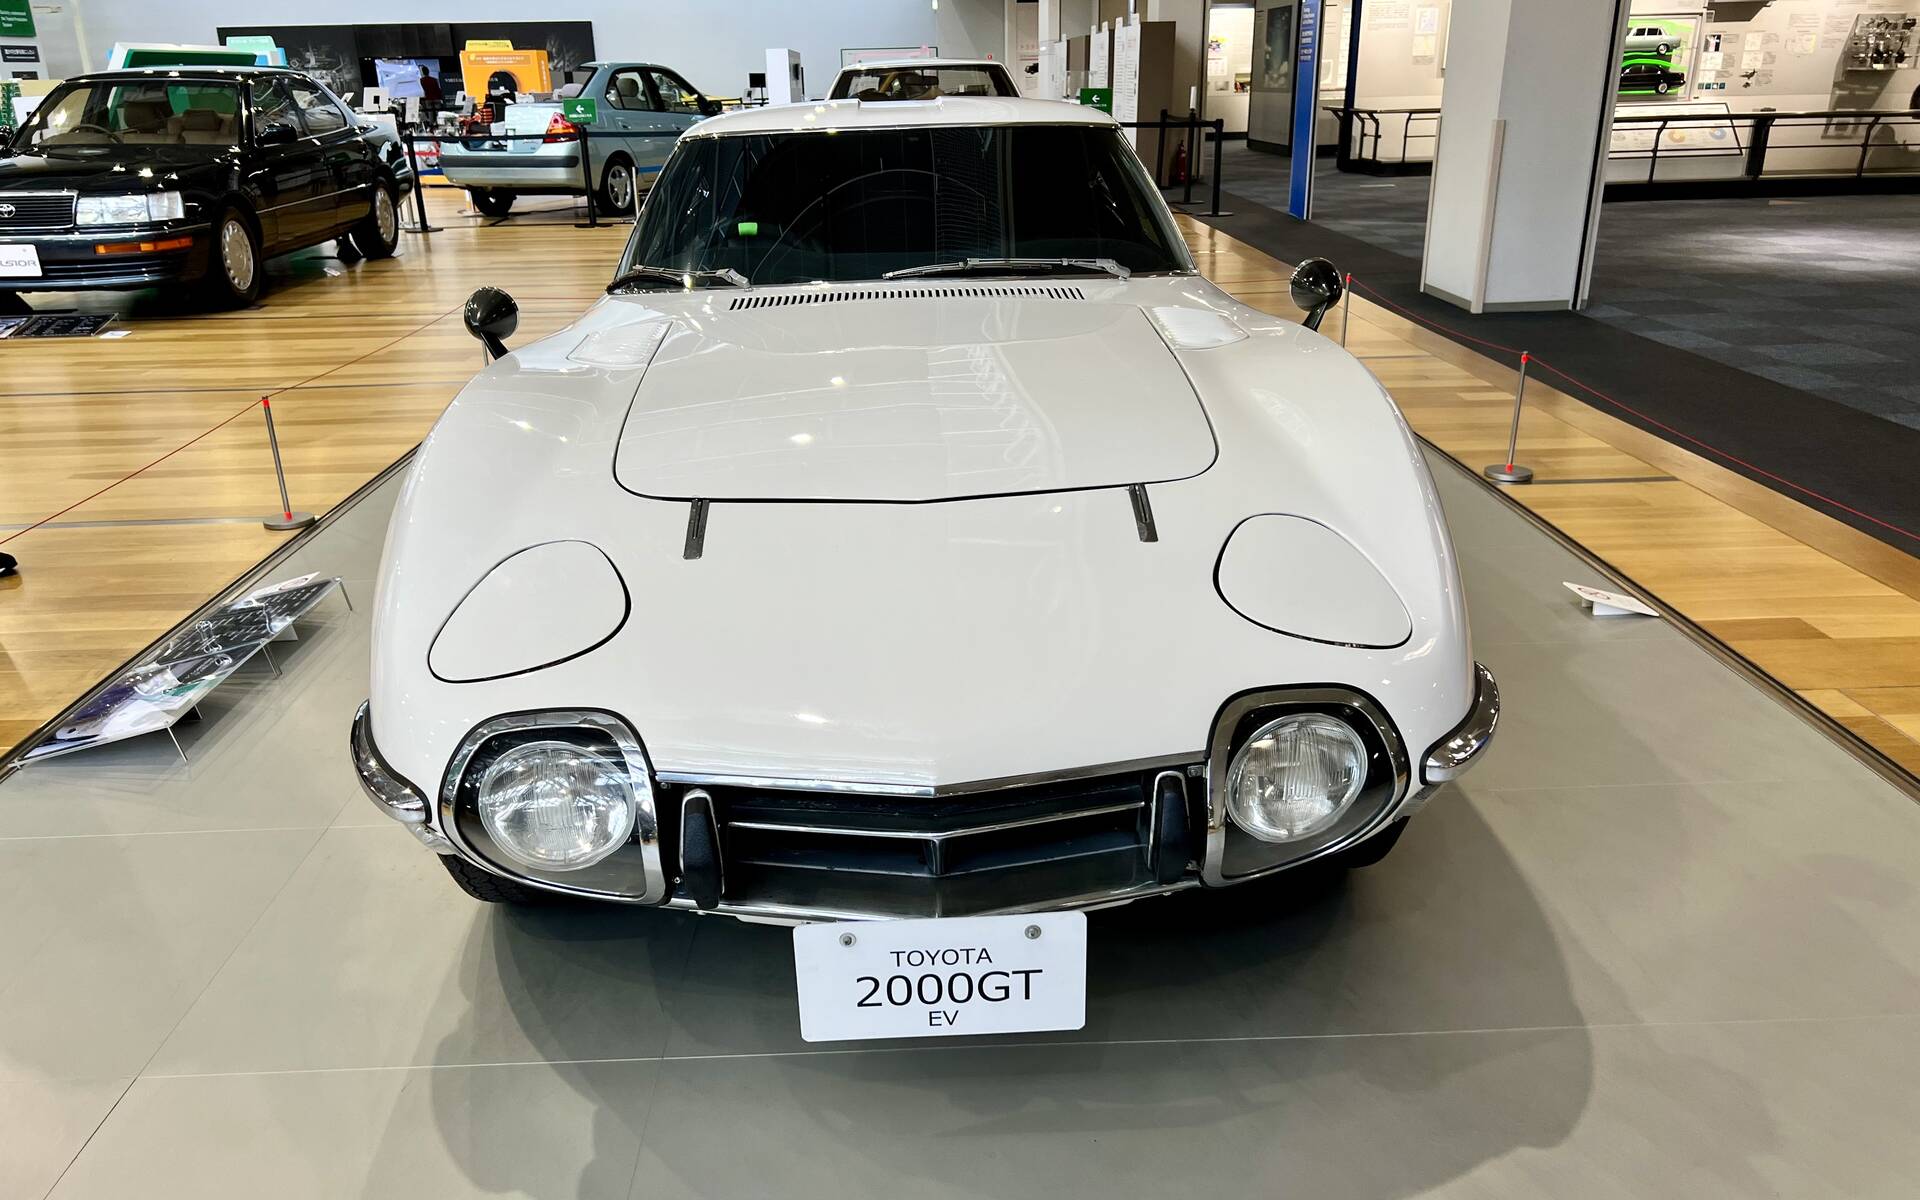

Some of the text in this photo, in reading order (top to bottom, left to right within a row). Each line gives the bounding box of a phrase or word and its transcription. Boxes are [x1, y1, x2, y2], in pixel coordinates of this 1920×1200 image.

[890, 948, 992, 967] TOYOTA
[857, 969, 1043, 1007] 2000GT
[929, 1010, 958, 1026] EV
